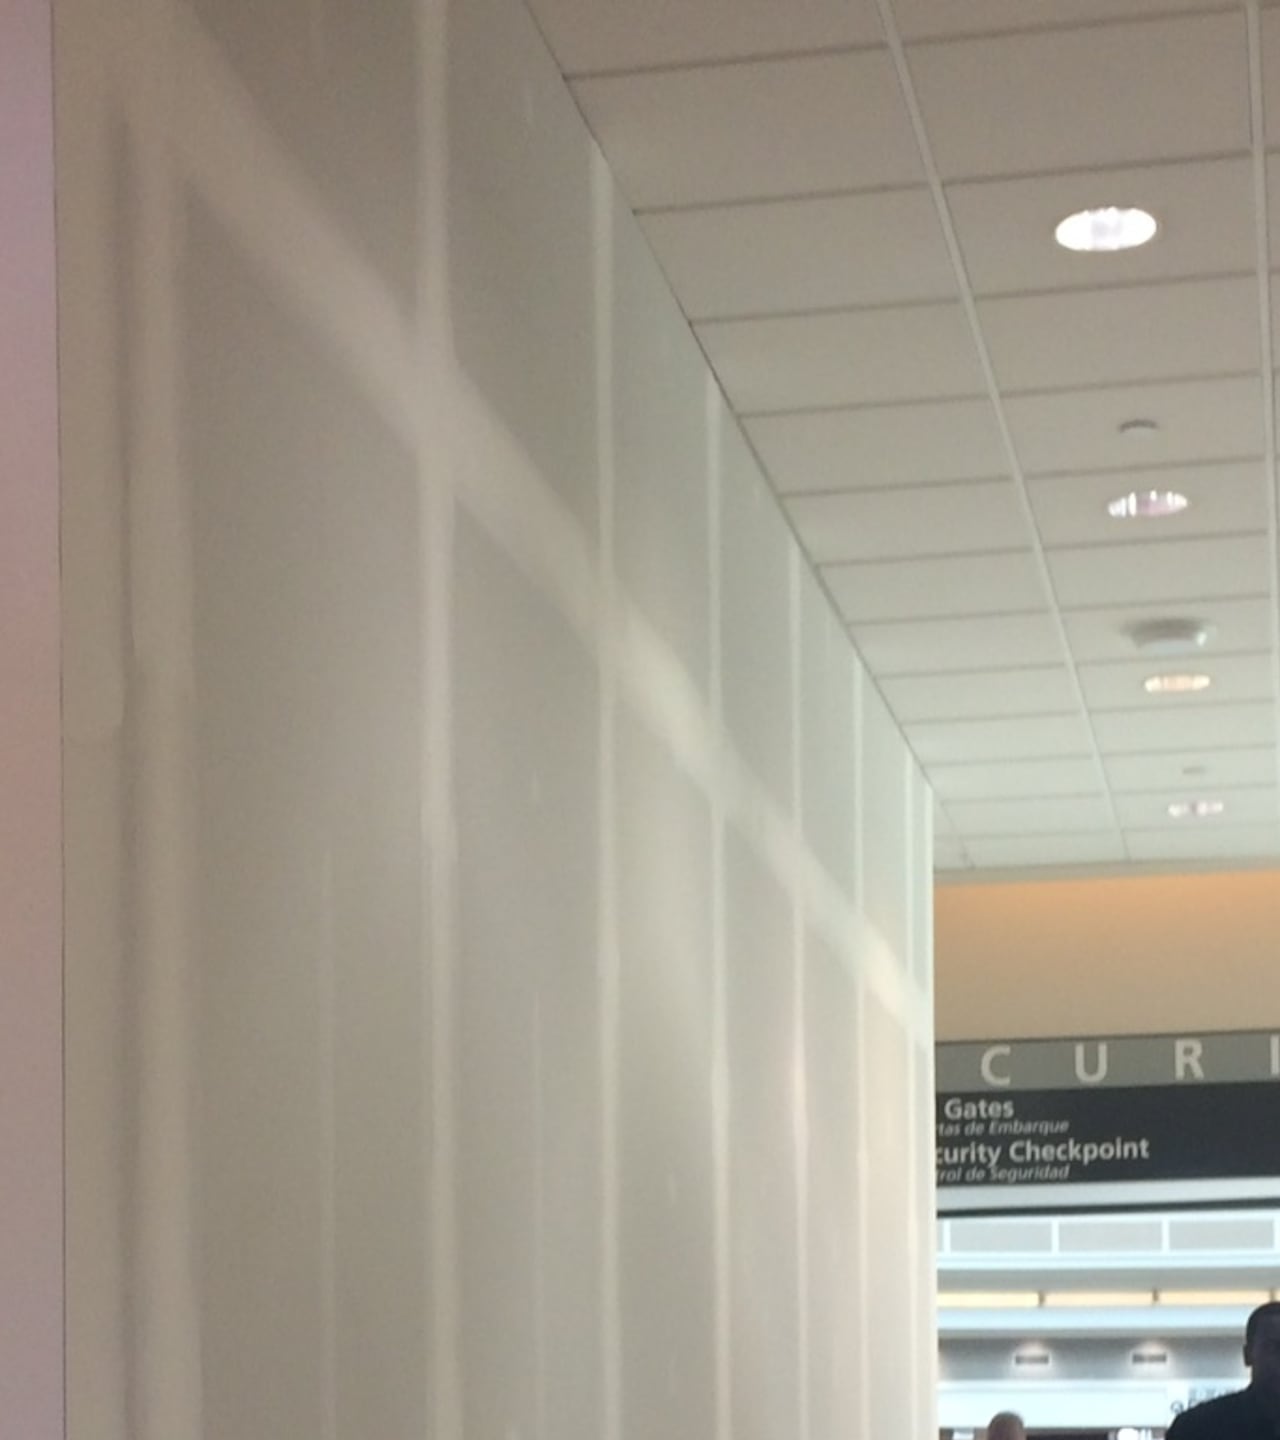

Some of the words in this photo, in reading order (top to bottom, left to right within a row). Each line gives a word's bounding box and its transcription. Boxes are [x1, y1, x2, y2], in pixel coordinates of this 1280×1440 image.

[944, 1097, 1014, 1120] Gates
[964, 1121, 984, 1136] de
[989, 1119, 1069, 1136] Embarque
[1009, 1136, 1150, 1166] Checkpoint
[937, 1167, 961, 1182] rol
[965, 1166, 986, 1181] de
[990, 1163, 1071, 1184] Seguridad
